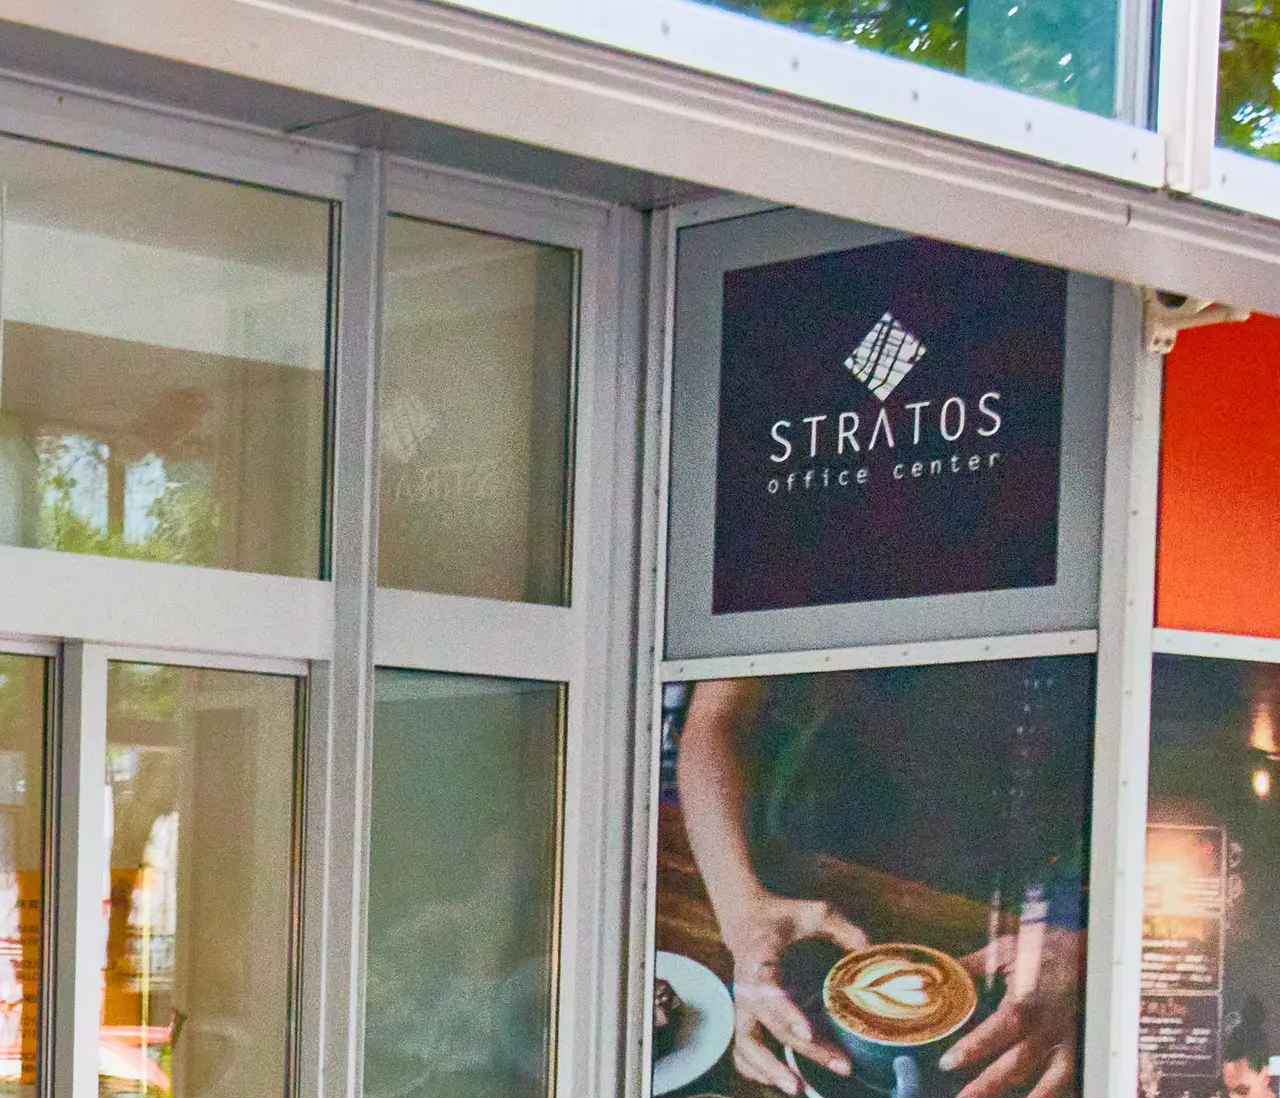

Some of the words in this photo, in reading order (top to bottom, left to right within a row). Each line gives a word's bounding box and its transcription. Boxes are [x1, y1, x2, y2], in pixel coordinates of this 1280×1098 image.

[769, 391, 1002, 463] STRATOS
[767, 467, 869, 495] office
[893, 451, 1002, 480] center
